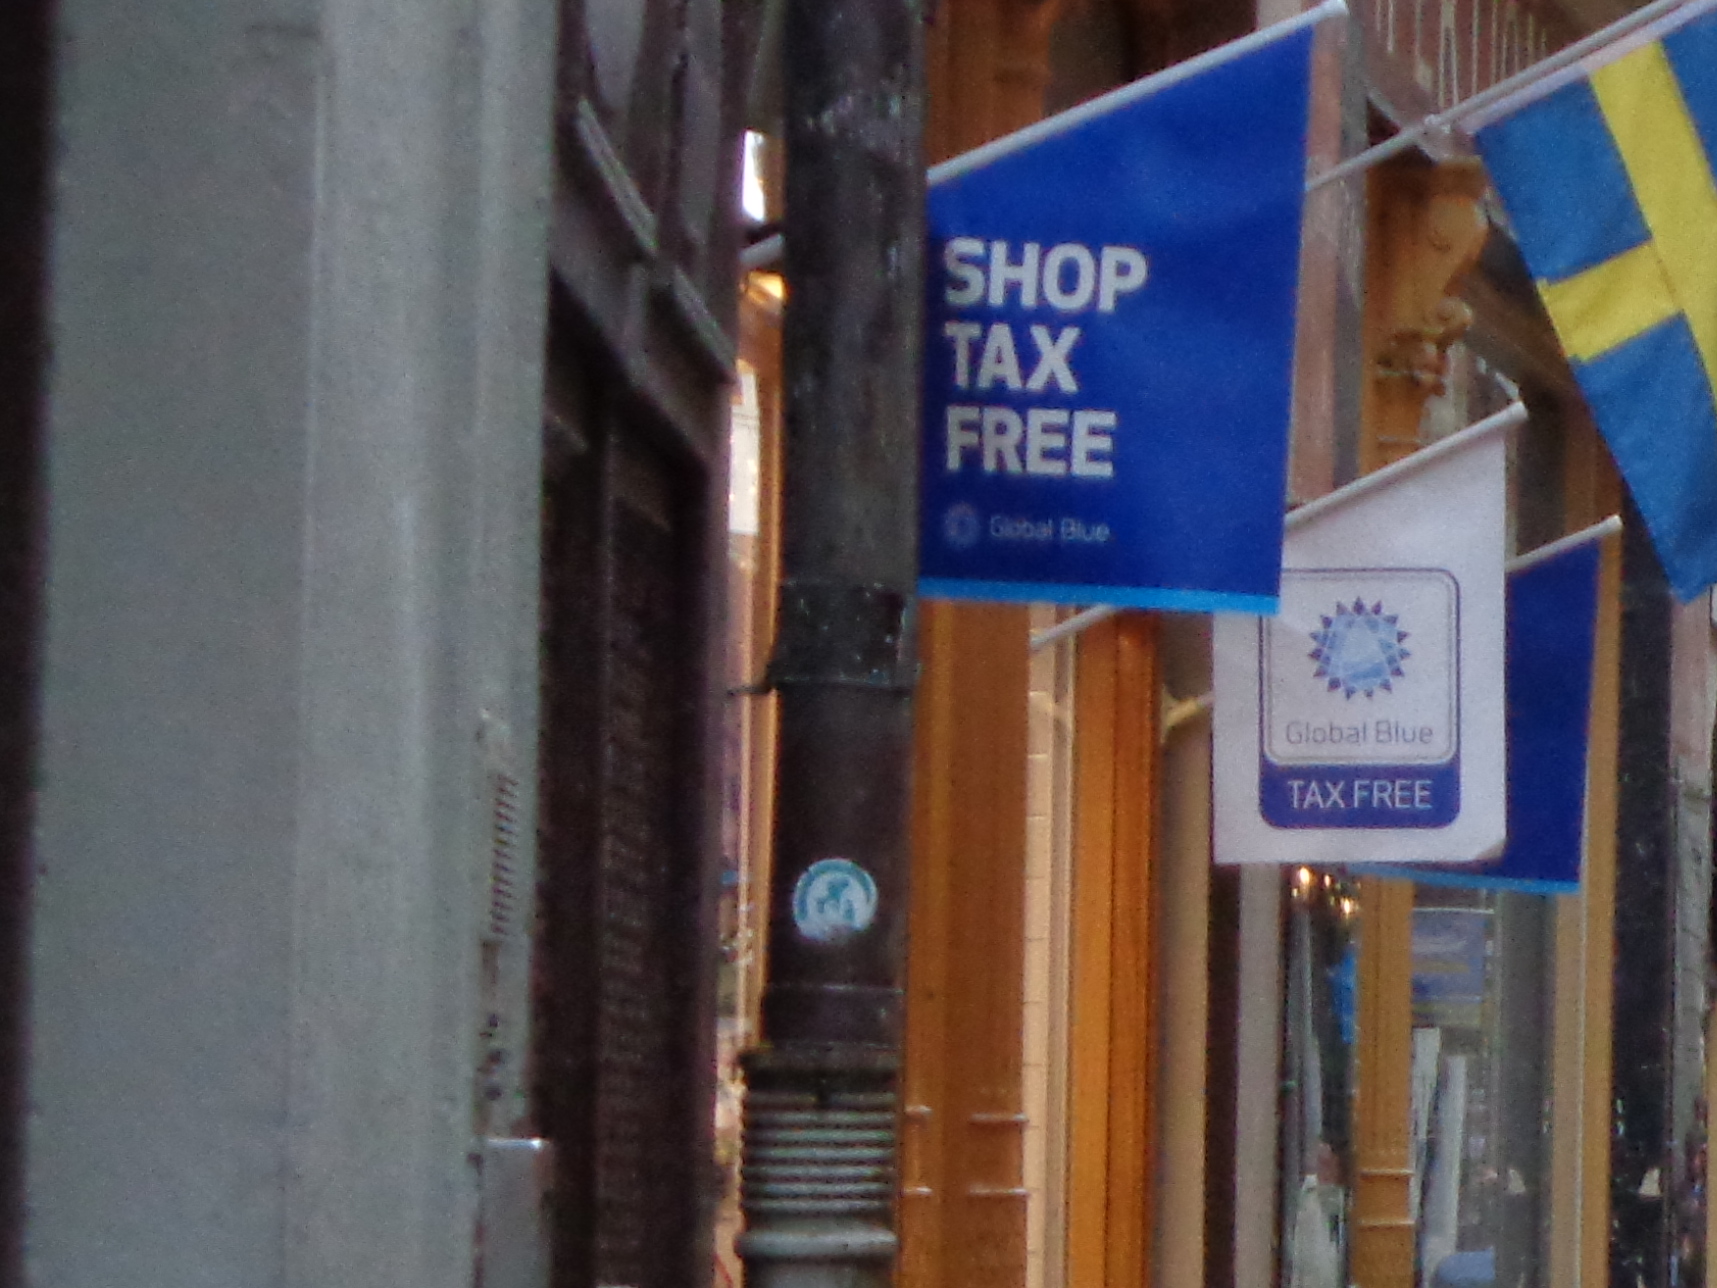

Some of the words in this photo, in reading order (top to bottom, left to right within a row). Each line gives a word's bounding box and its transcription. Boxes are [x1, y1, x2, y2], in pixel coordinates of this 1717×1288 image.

[944, 236, 1149, 313] SHOP
[944, 321, 1081, 394] TAX
[945, 405, 1118, 479] FREE
[989, 515, 1053, 541] Global
[1059, 517, 1111, 544] Blue
[1285, 721, 1367, 744] Global
[1375, 720, 1434, 744] Blue
[1287, 780, 1345, 809] TAX
[1353, 780, 1433, 809] FREE
